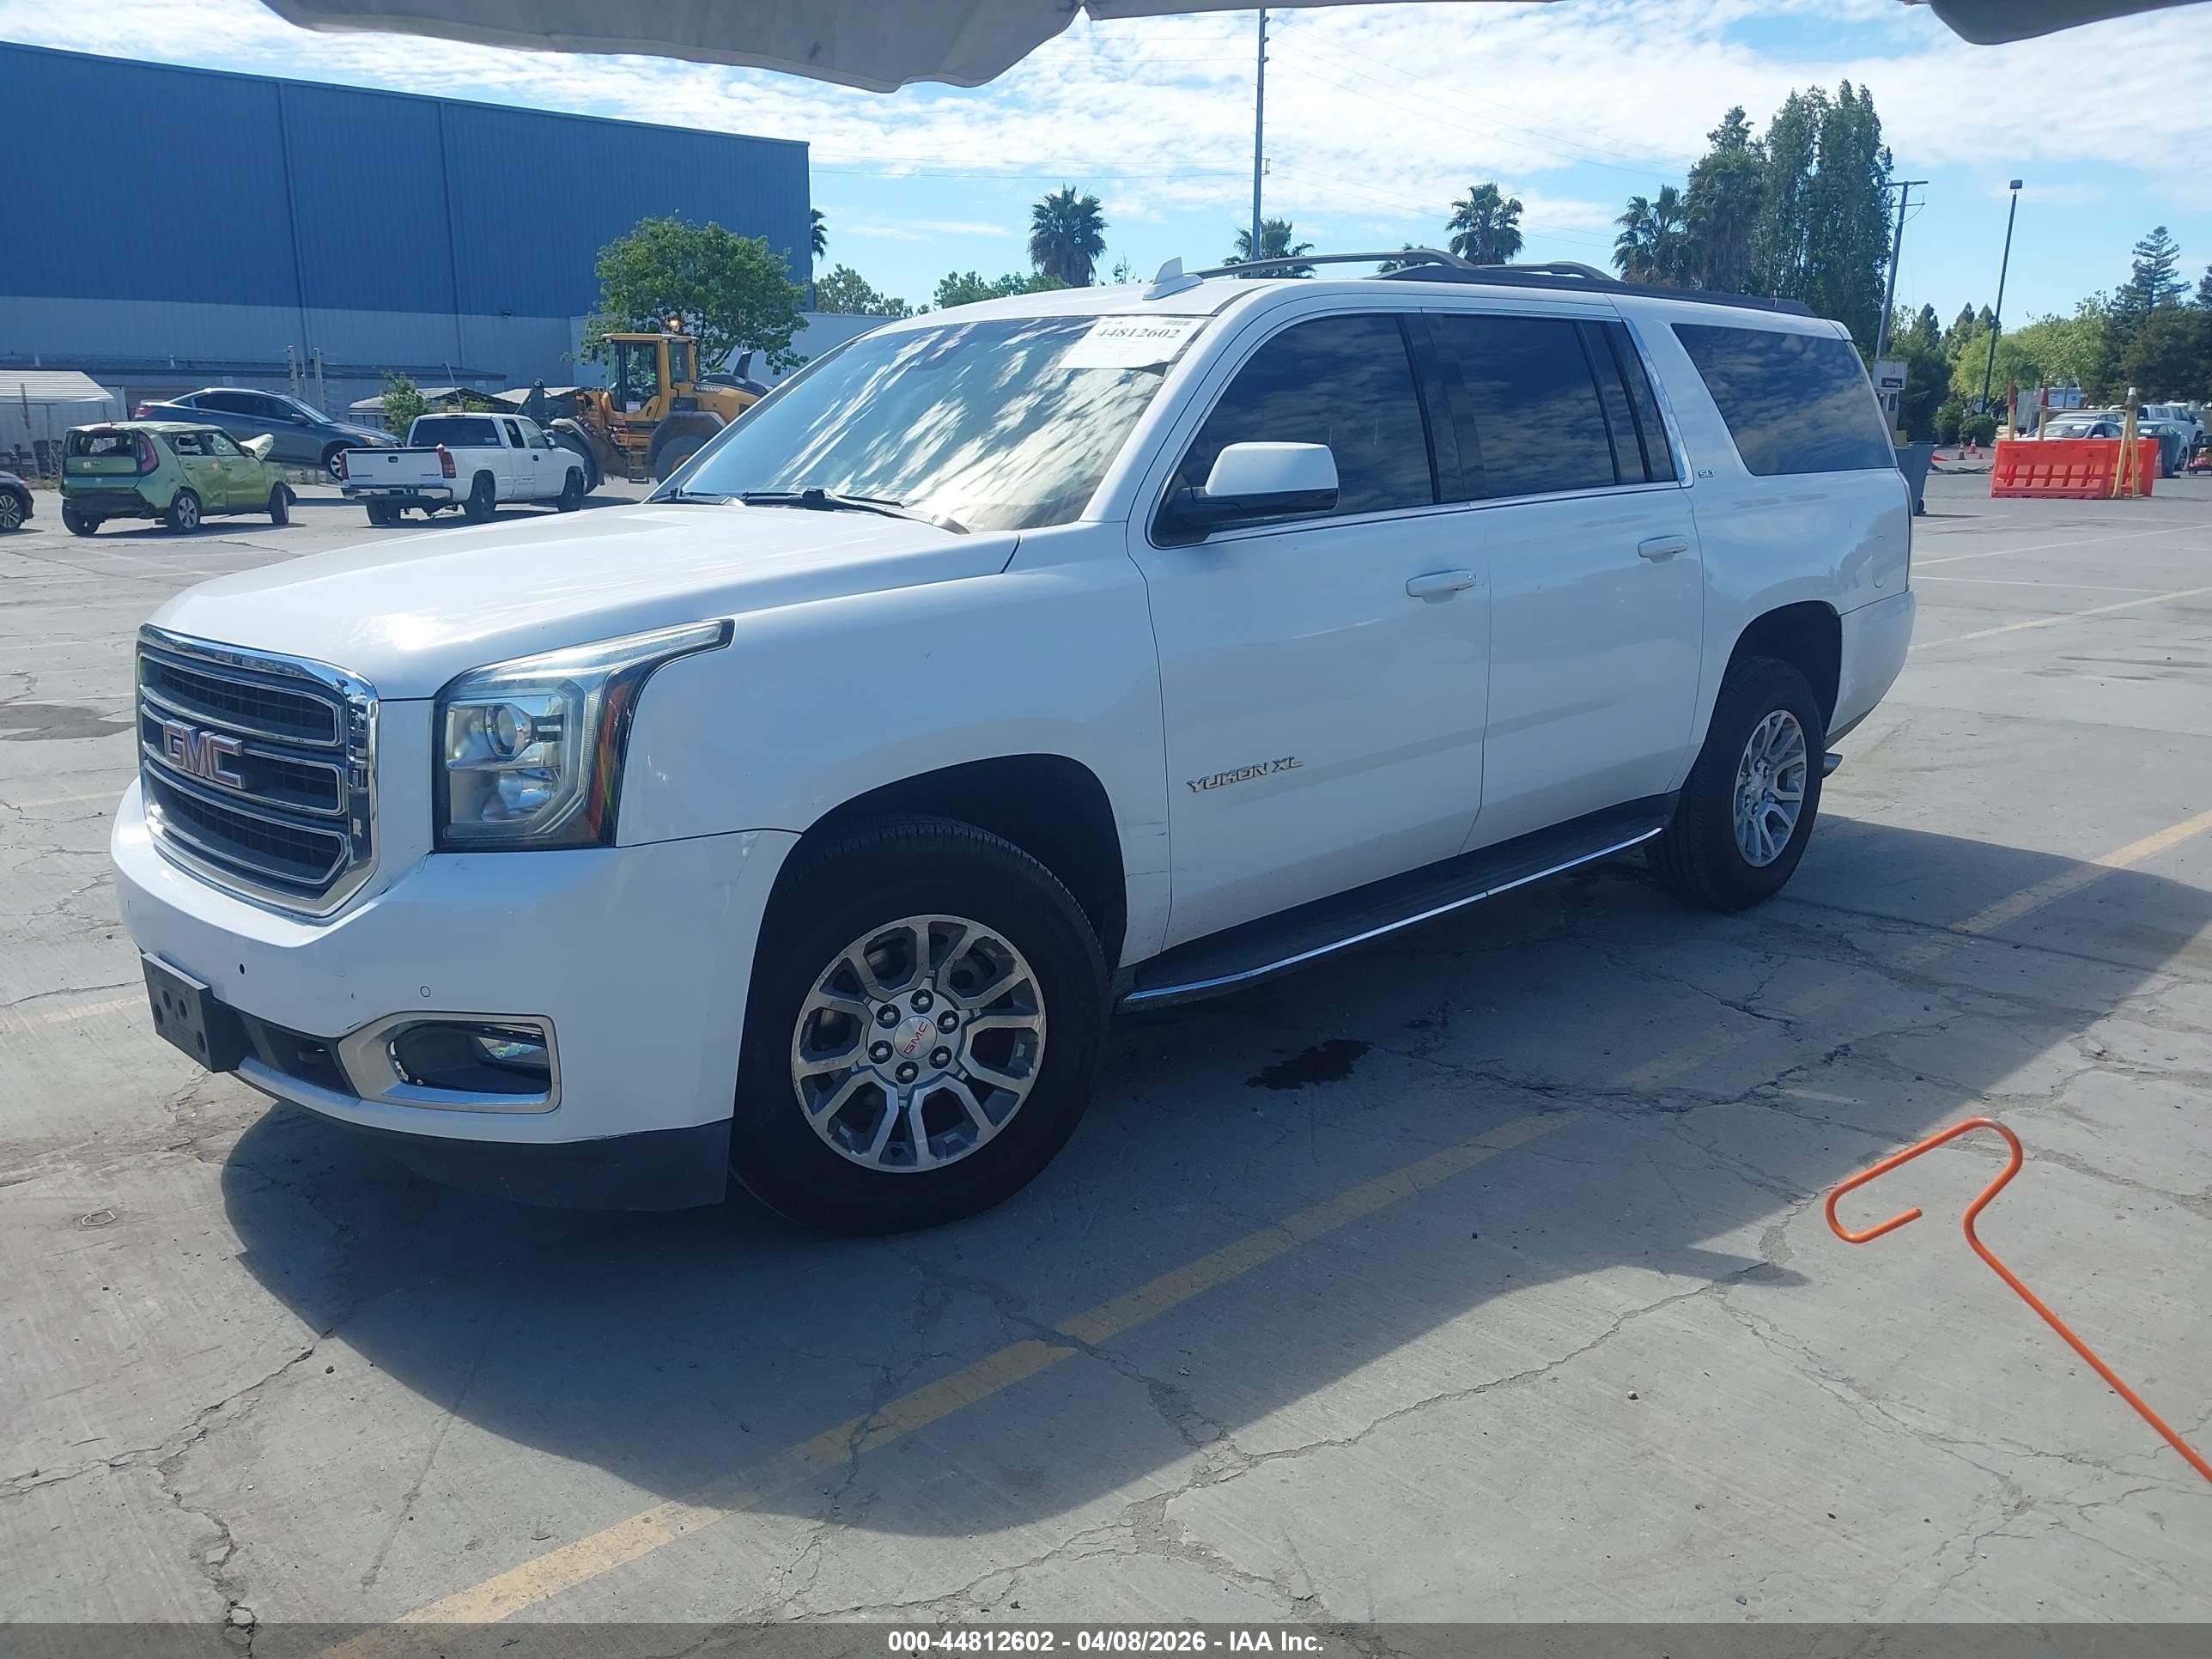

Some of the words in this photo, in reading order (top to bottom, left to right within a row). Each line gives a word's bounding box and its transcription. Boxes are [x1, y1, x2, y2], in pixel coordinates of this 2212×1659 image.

[1096, 327, 1181, 338] 44812602
[1698, 469, 1717, 479] SLT
[163, 719, 246, 790] GMC
[1186, 762, 1269, 793] YUKON
[1271, 755, 1304, 774] XL
[902, 1021, 928, 1055] GMC
